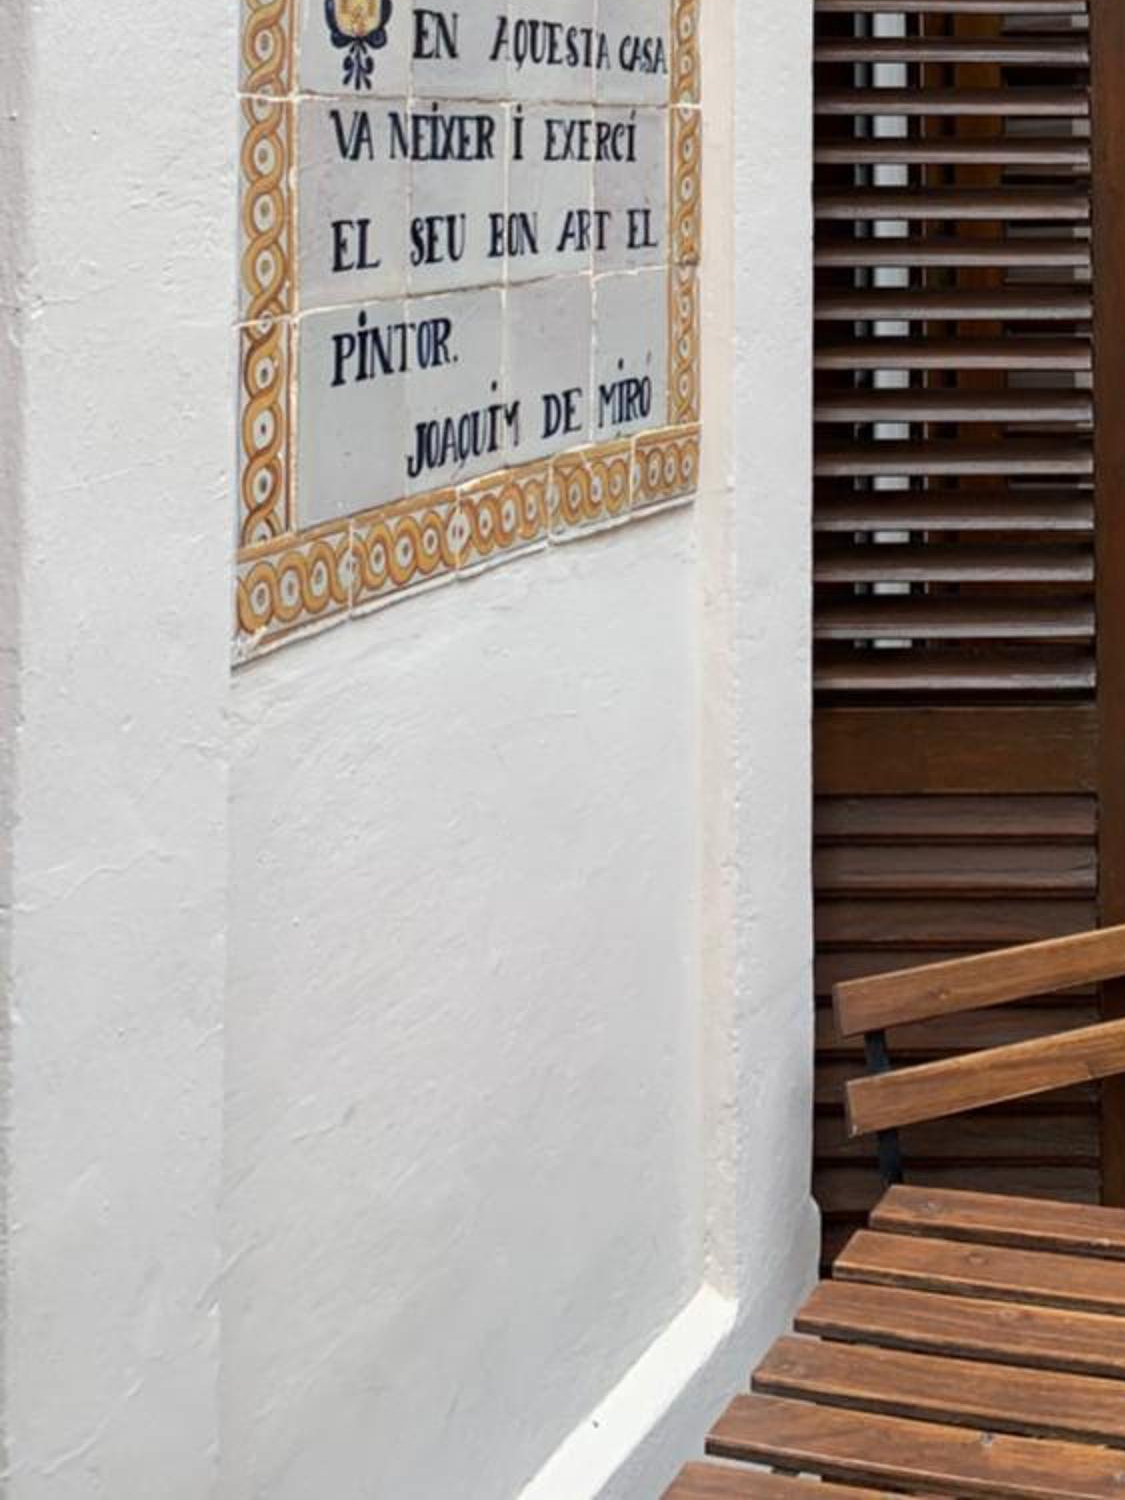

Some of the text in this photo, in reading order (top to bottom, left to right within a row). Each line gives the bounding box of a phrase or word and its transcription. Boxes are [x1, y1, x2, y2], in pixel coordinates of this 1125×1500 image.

[413, 9, 667, 74] EN AQUESTA CASA
[330, 109, 373, 161] VA
[331, 208, 658, 272] EL SEU BON ART EL
[407, 353, 651, 478] JOAQUIM DE MIRÓ
